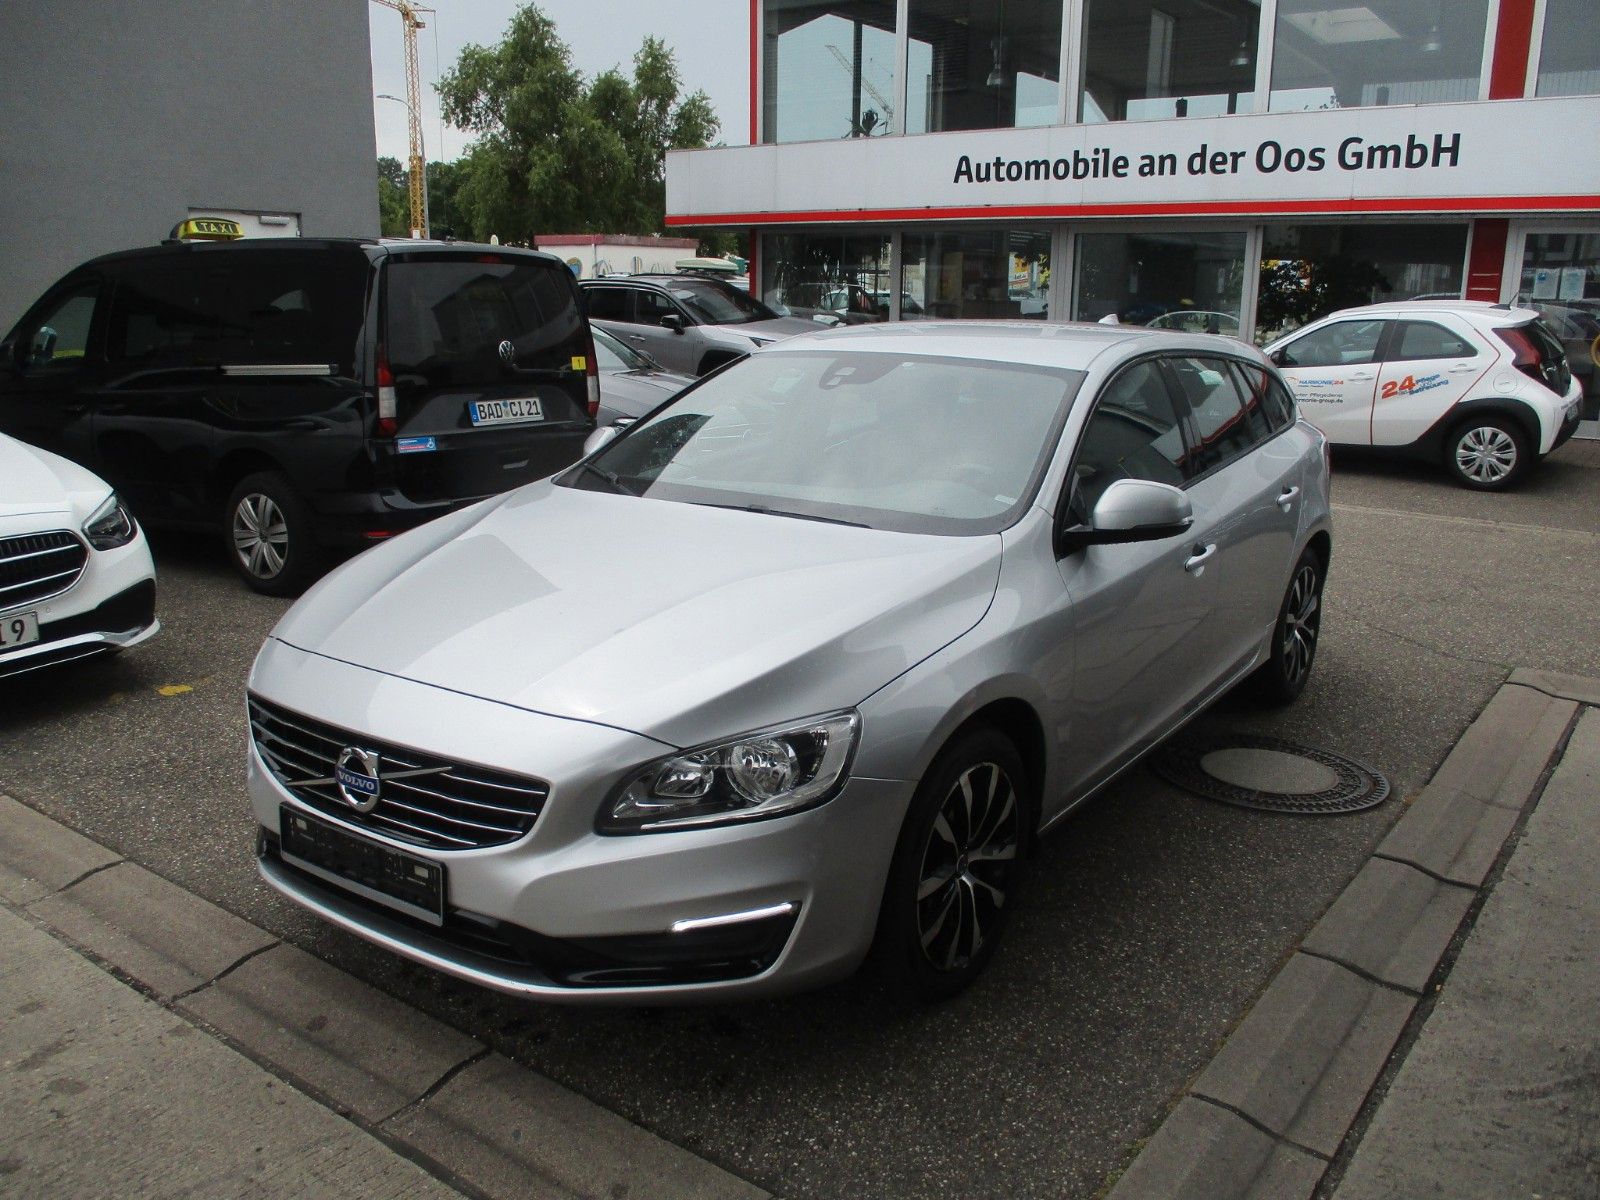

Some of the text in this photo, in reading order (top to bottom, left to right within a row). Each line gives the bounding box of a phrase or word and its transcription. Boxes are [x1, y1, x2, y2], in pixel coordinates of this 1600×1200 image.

[954, 133, 1461, 184] Automobile an der Oos GmbH
[200, 222, 233, 234] TAXI
[1381, 375, 1416, 399] 24
[478, 402, 503, 420] BAD
[509, 401, 525, 417] CI
[525, 400, 541, 416] 21
[338, 769, 375, 790] VOLVO
